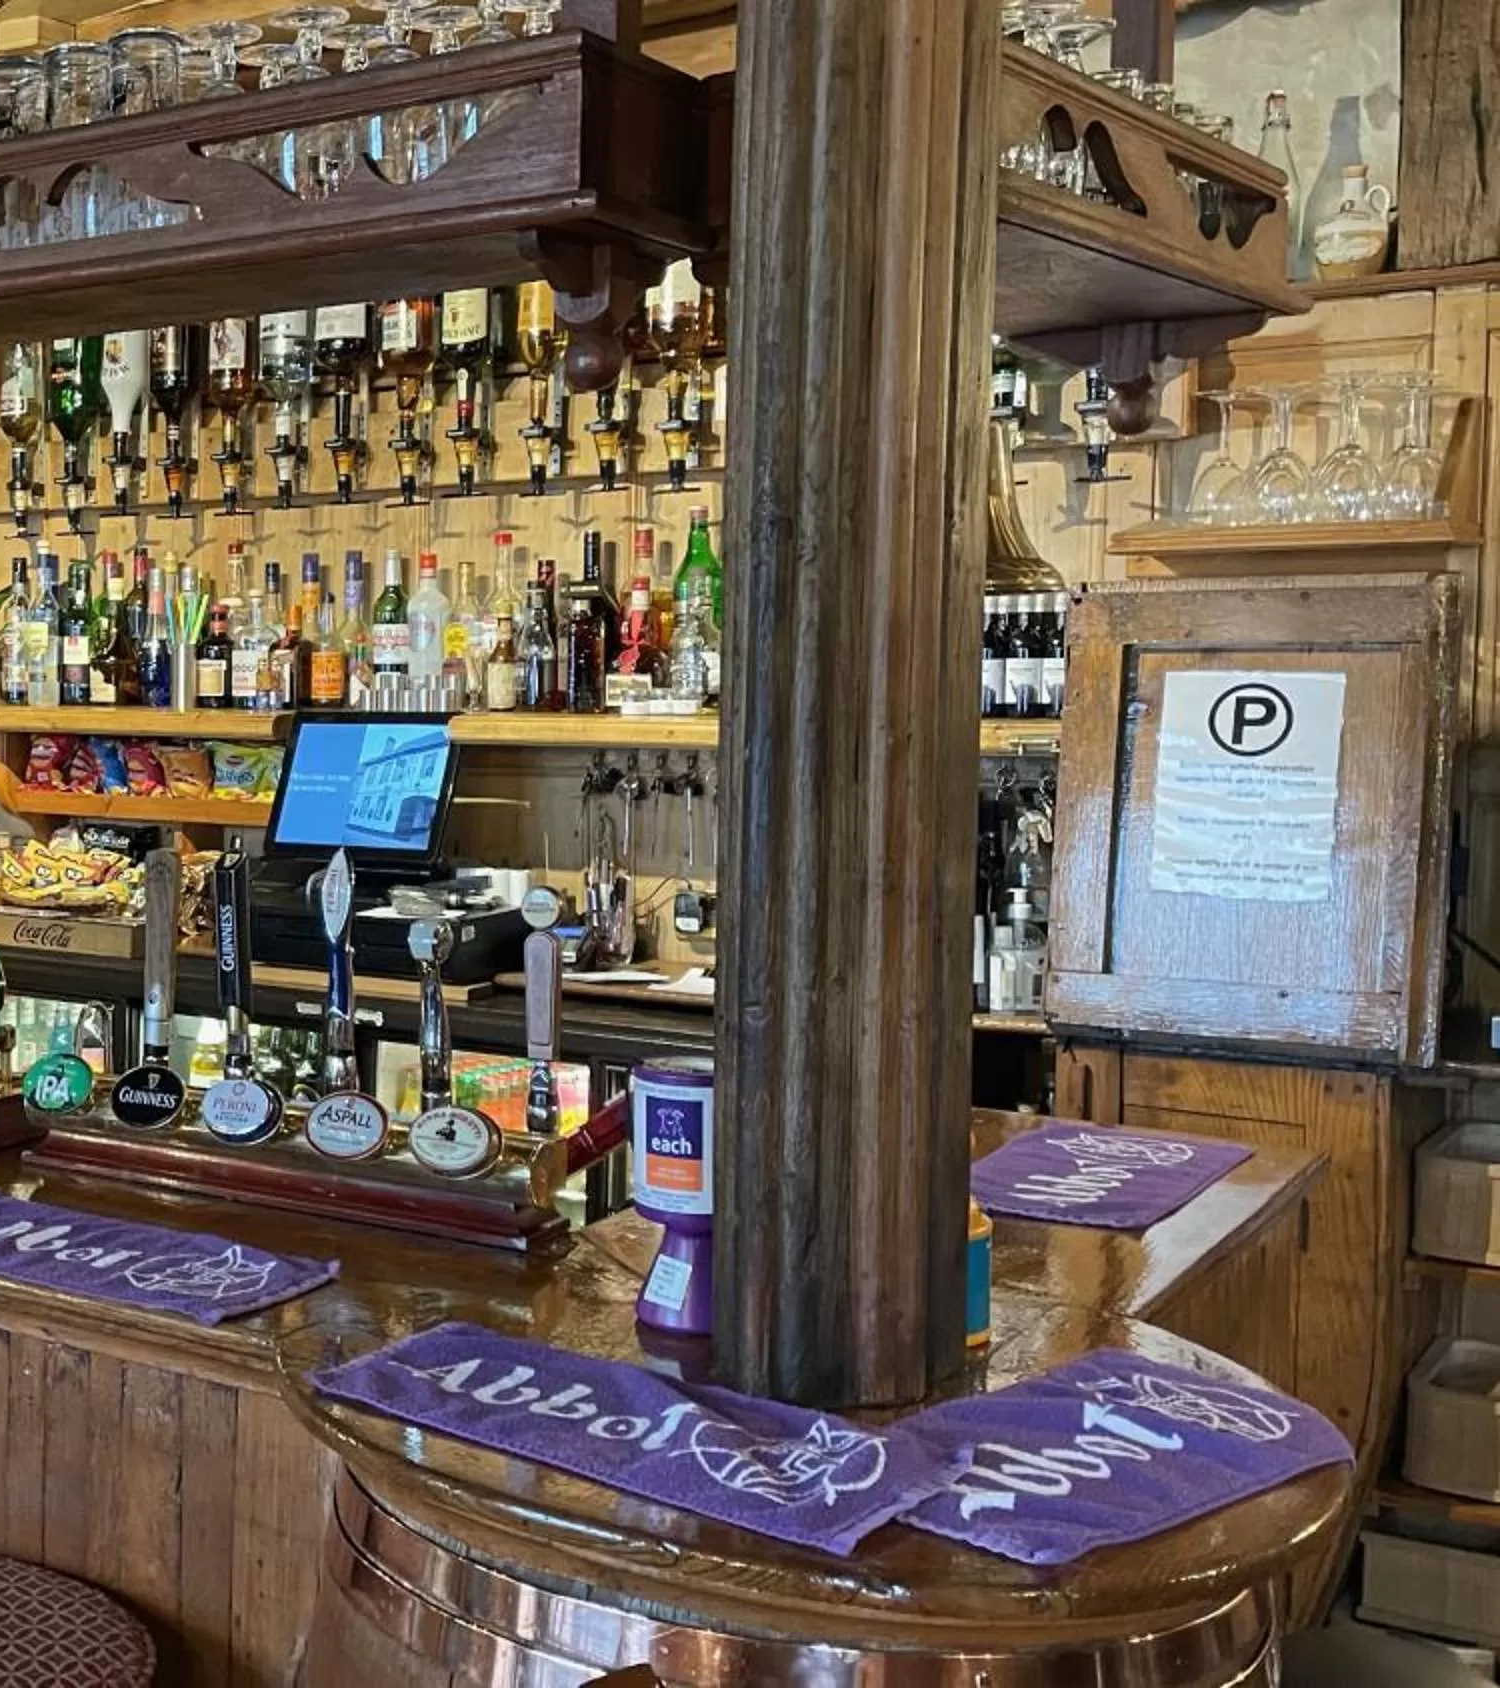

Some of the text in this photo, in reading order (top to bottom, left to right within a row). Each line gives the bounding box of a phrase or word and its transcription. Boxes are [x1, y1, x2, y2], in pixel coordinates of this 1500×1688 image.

[1231, 696, 1277, 745] P
[220, 904, 235, 972] GUINNESS
[34, 1075, 69, 1102] IPA
[118, 1086, 178, 1109] GUINNESS
[318, 1105, 373, 1129] ASPALL
[651, 1136, 692, 1155] each
[387, 1357, 703, 1452] Abbot
